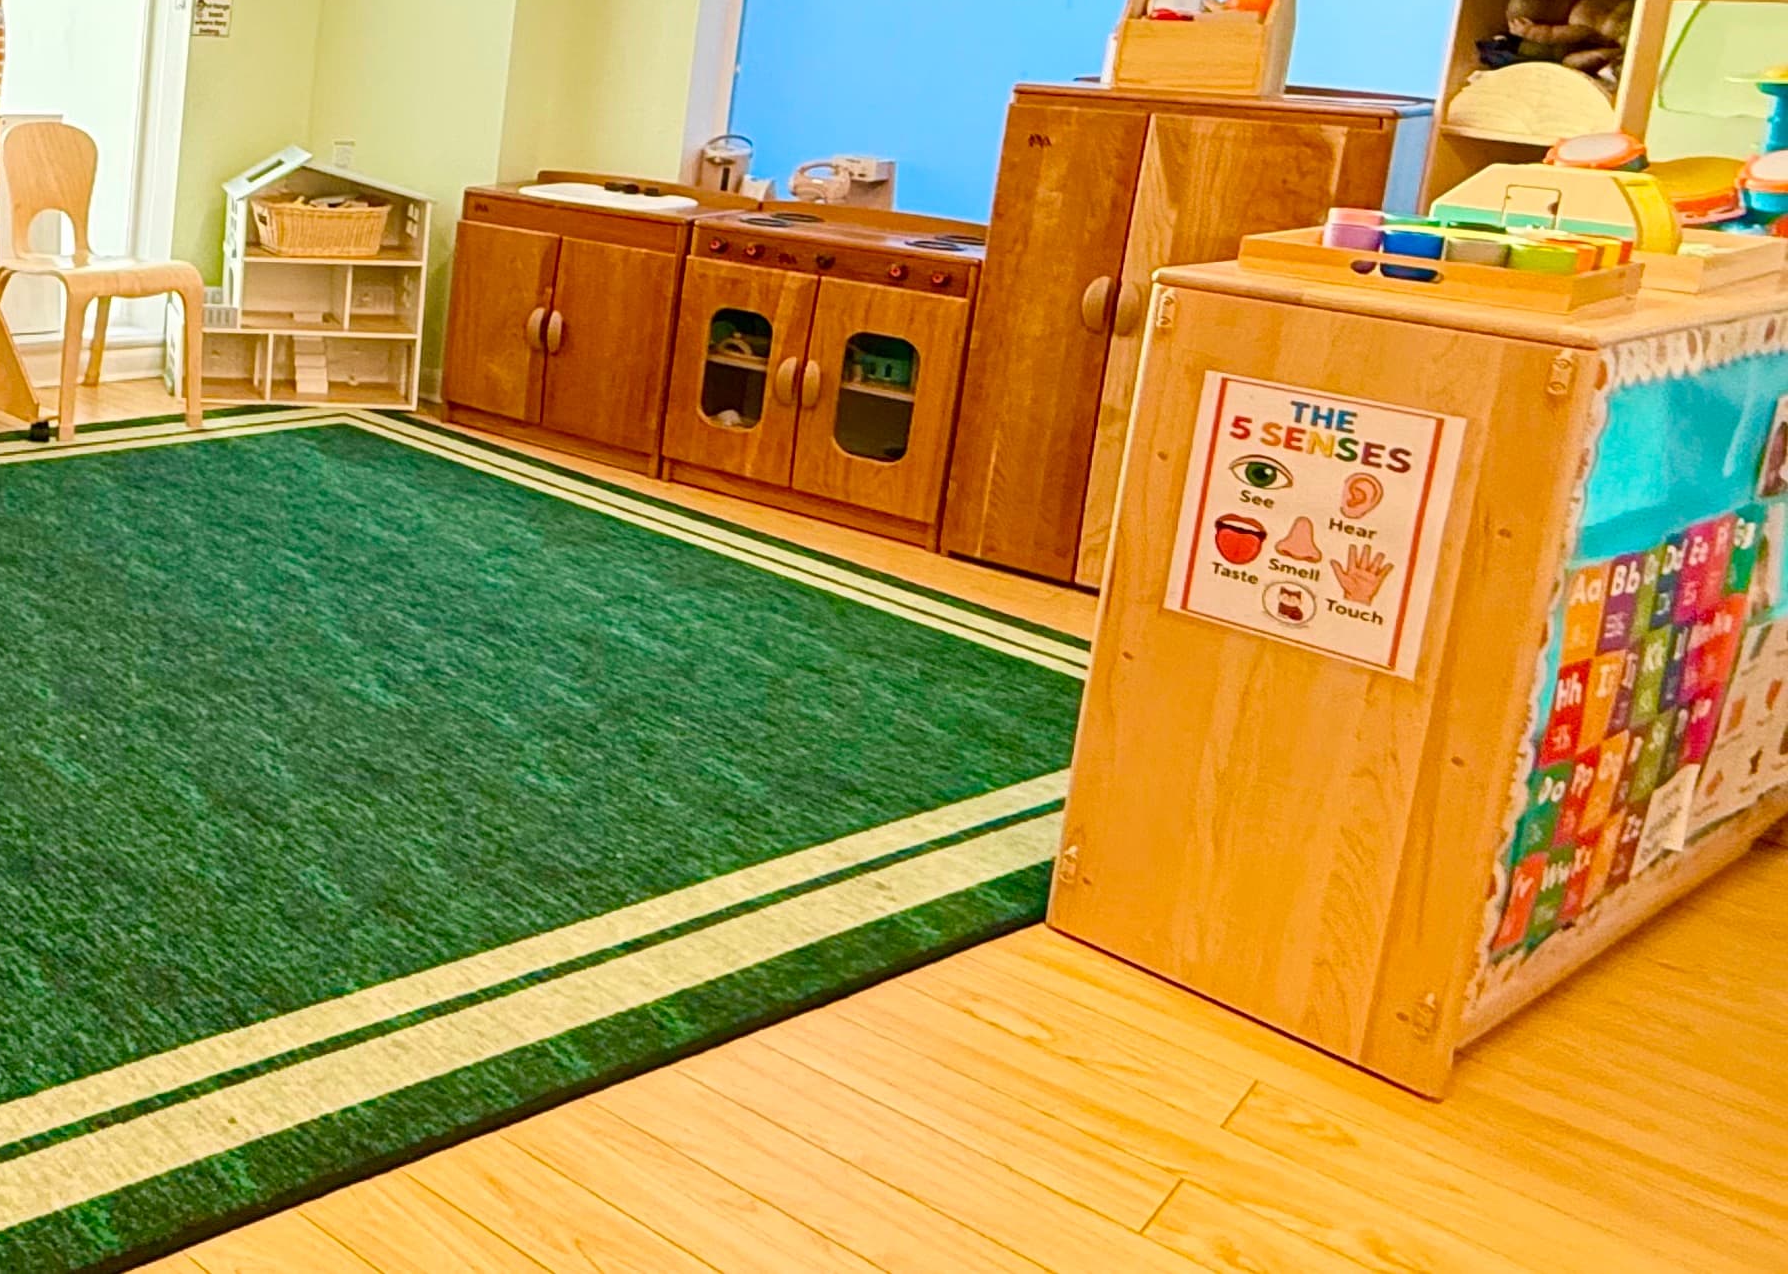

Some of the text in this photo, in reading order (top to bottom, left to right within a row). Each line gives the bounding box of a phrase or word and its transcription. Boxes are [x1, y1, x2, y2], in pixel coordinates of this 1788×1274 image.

[1290, 400, 1357, 433] THE
[1229, 416, 1412, 473] 5 SENSES
[1239, 490, 1275, 508] See
[1328, 517, 1378, 540] Hear
[1212, 562, 1260, 585] Taste
[1268, 558, 1321, 582] Smell
[1570, 573, 1603, 605] Aa
[1610, 560, 1641, 597] Bb
[1326, 599, 1384, 625] Touch
[1555, 671, 1583, 712] Hh
[1538, 776, 1567, 805] Oo
